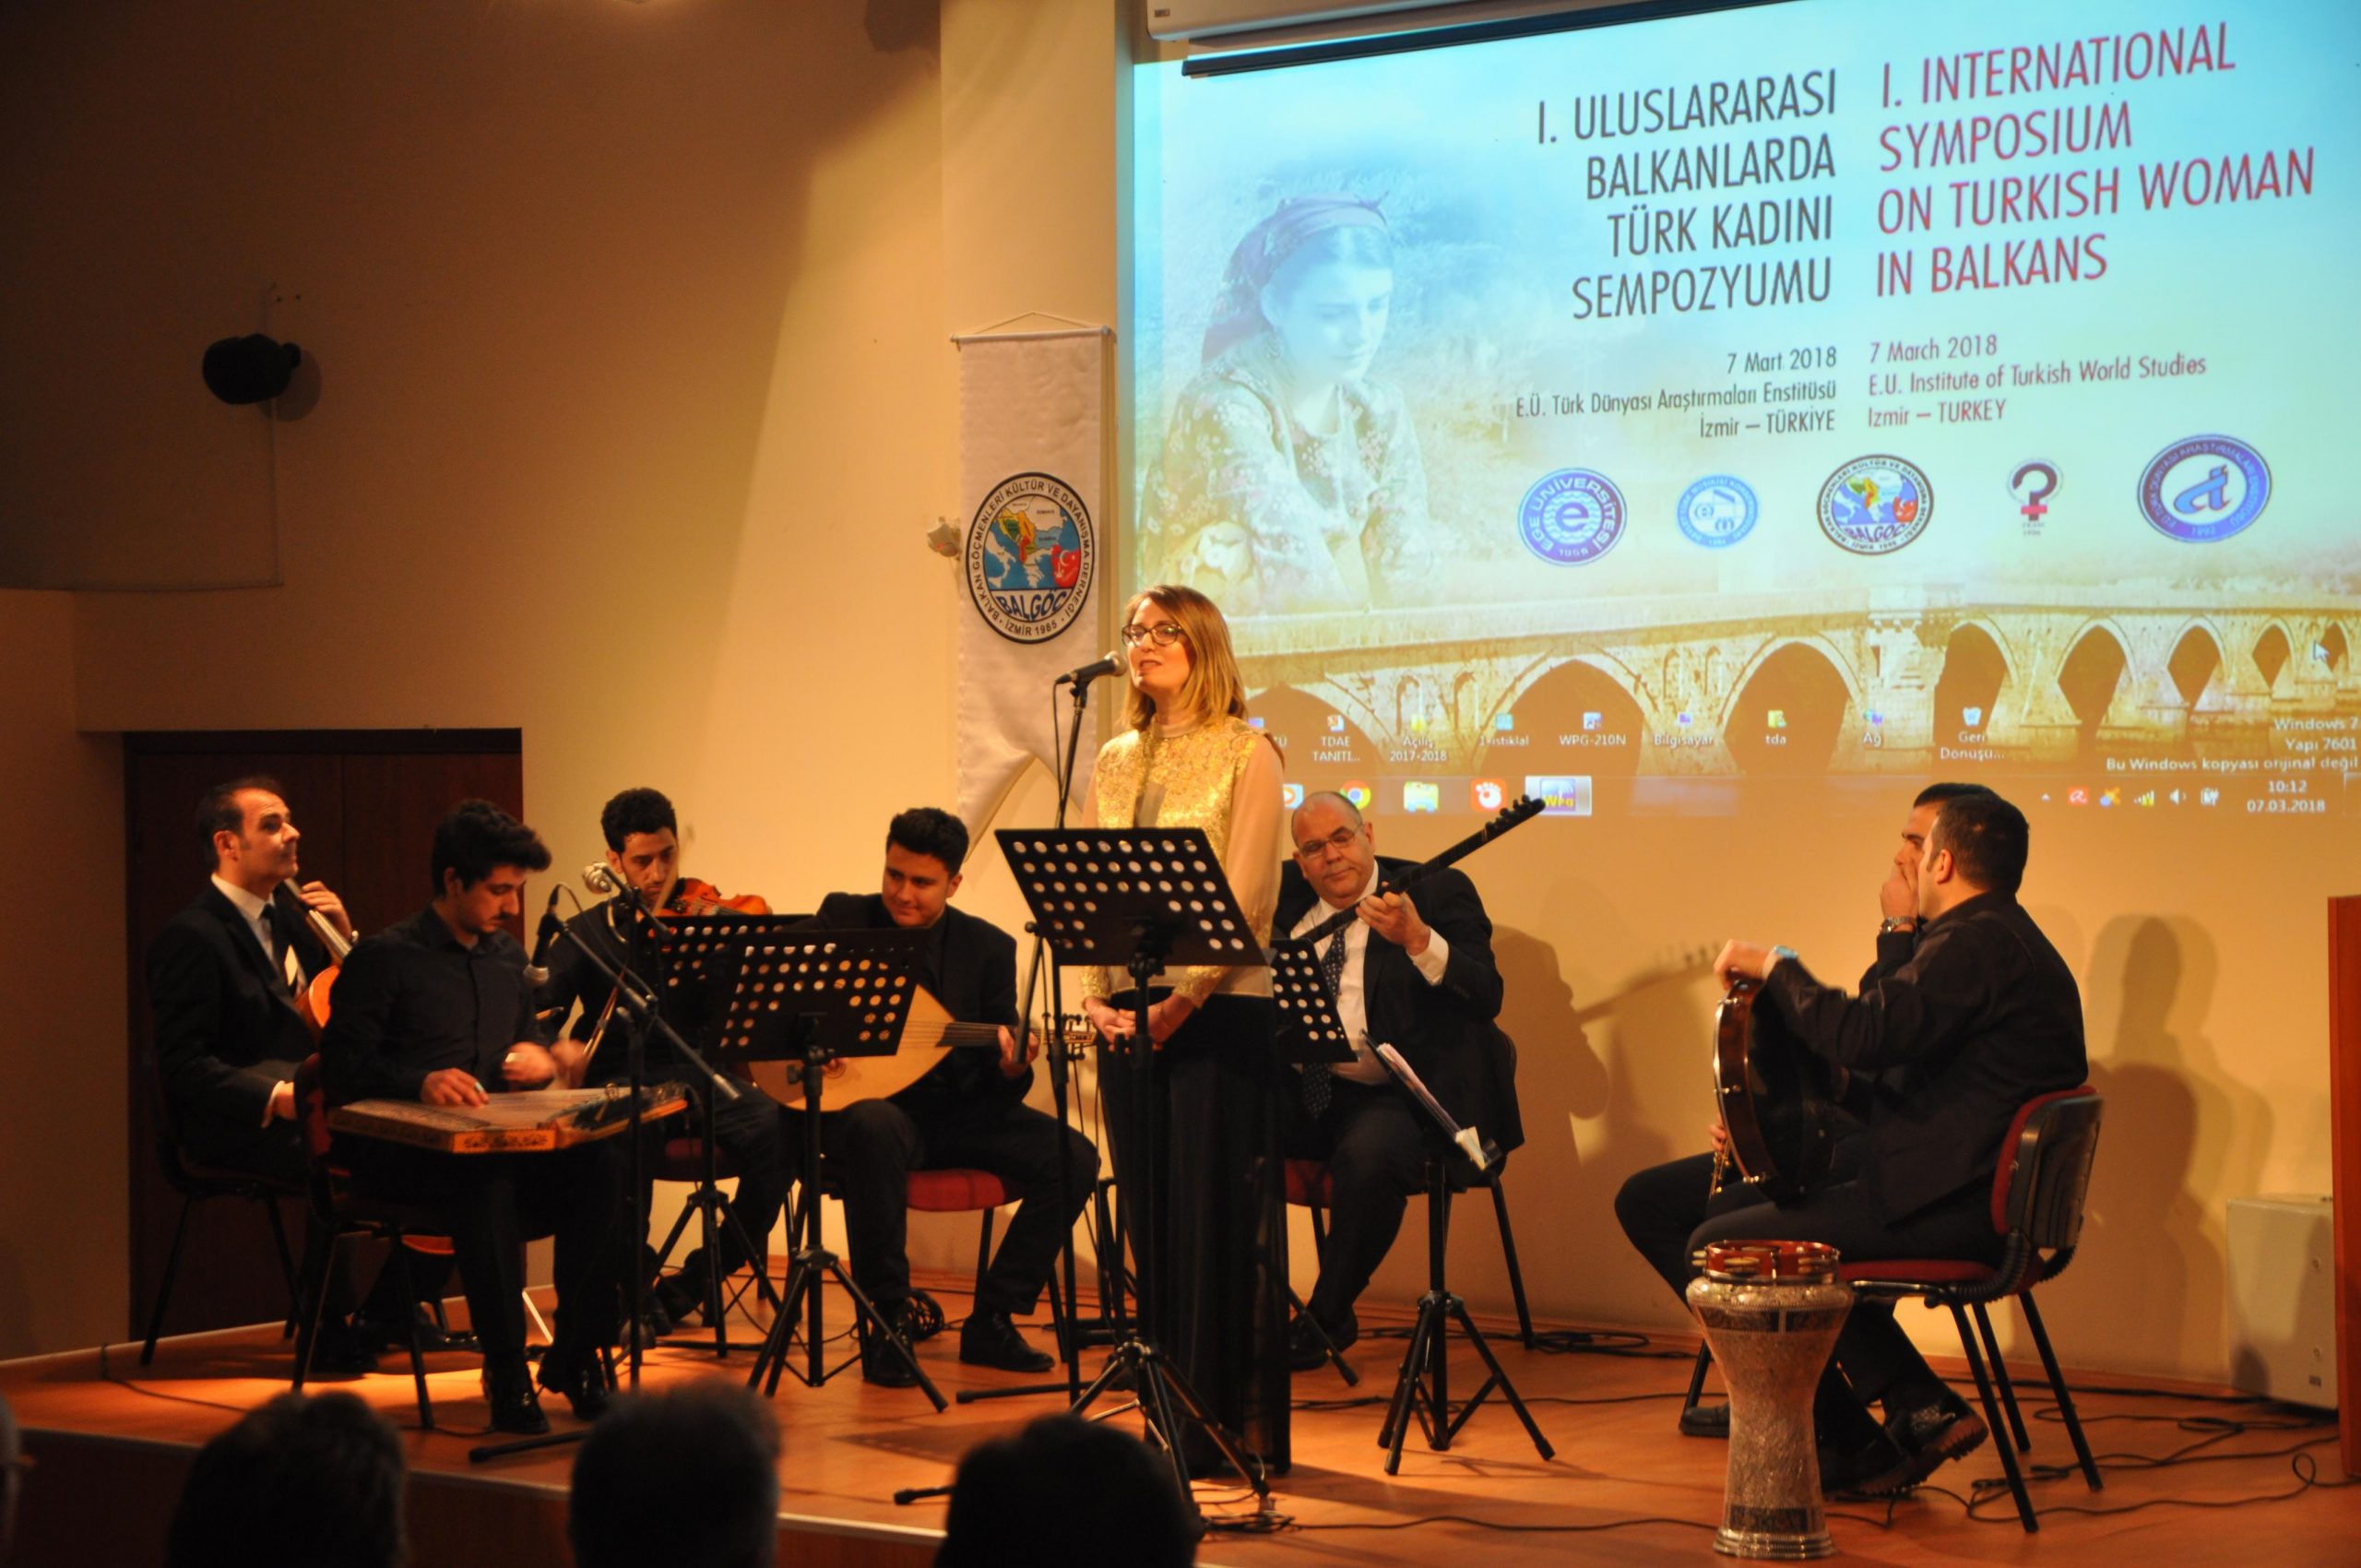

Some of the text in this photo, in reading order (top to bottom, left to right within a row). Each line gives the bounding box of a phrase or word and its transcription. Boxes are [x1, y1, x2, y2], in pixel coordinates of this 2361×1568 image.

[1882, 21, 2236, 108] I. INTERNATIONAL
[1538, 68, 1836, 144] I. ULUSLARARASI
[1880, 101, 2132, 172] SYMPOSIUM
[1587, 133, 1836, 200] BALKANLARDA
[1878, 146, 2314, 234] ON TURKISH WOMAN
[1608, 195, 1833, 257] TÜRK KADINI
[1877, 233, 2107, 297] IN BALKANS
[1572, 256, 1832, 319] SEMPOZYUMU
[1727, 346, 1837, 374] 7 Mart 2018
[1870, 334, 1998, 363] 7 March 2018
[1869, 351, 2207, 396] E.U. Institute of Turkish World Studies
[1552, 393, 1584, 415] Türk
[1591, 392, 1653, 417] Dünyası
[1656, 384, 1757, 412] Araştırmaları
[1763, 379, 1836, 404] Enstitüsü
[1869, 406, 1910, 427] Izmir
[1939, 398, 2007, 423] TURKEY
[1700, 411, 1739, 438] İzmir
[1766, 406, 1835, 434] TÜRKİYE
[1530, 517, 1554, 552] EGE
[974, 574, 1000, 621] BALKAN
[1005, 479, 1045, 496] KÜLTÜR
[1048, 484, 1061, 497] VE
[1035, 620, 1058, 635] 1985
[1958, 731, 1986, 742] Geri
[2273, 716, 2359, 731] Windows 7
[1321, 736, 1351, 747] TDAE
[1560, 735, 1627, 746] WPG-210N
[1654, 733, 1714, 749] Bilgisayar
[1765, 734, 1787, 745] tda
[2323, 737, 2356, 751] 7601
[1390, 750, 1447, 762] 2017-2018
[2106, 757, 2126, 771] Bu
[2130, 758, 2198, 770] Windows
[2201, 757, 2259, 773] kopyası
[2269, 780, 2308, 793] 10:12
[2247, 799, 2326, 812] 07.03.2018
